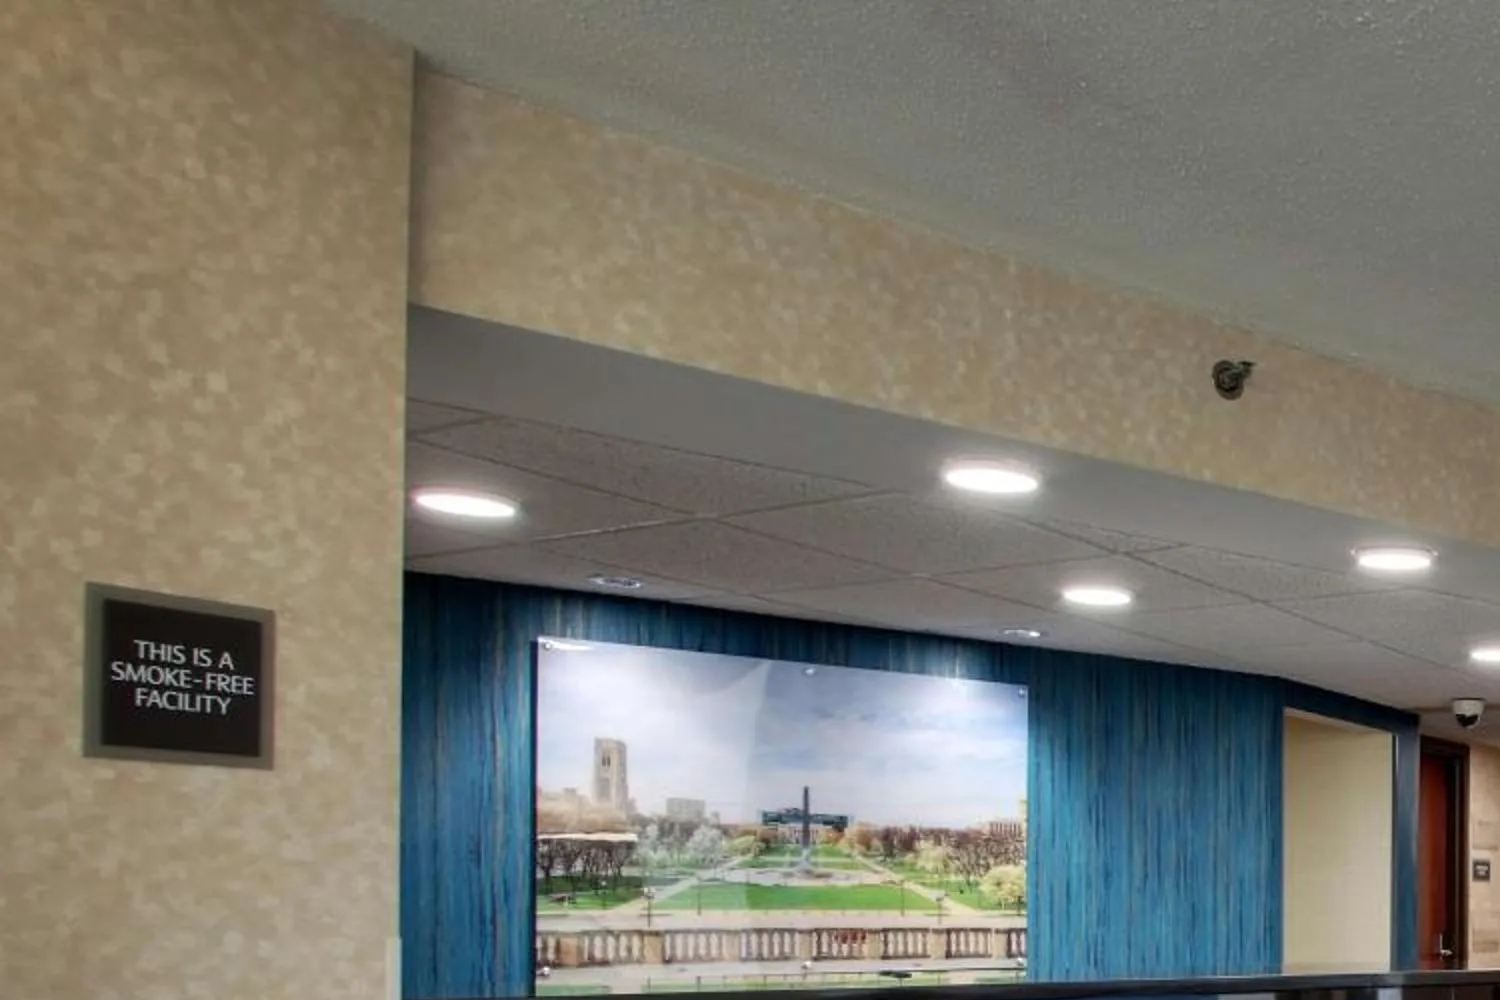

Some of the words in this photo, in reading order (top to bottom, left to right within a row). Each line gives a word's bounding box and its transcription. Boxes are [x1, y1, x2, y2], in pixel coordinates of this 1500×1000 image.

[133, 639, 186, 665] THIS
[193, 647, 212, 668] IS
[218, 651, 235, 671] A
[111, 660, 255, 696] SMOKE-FREE
[134, 687, 231, 716] FACILITY
